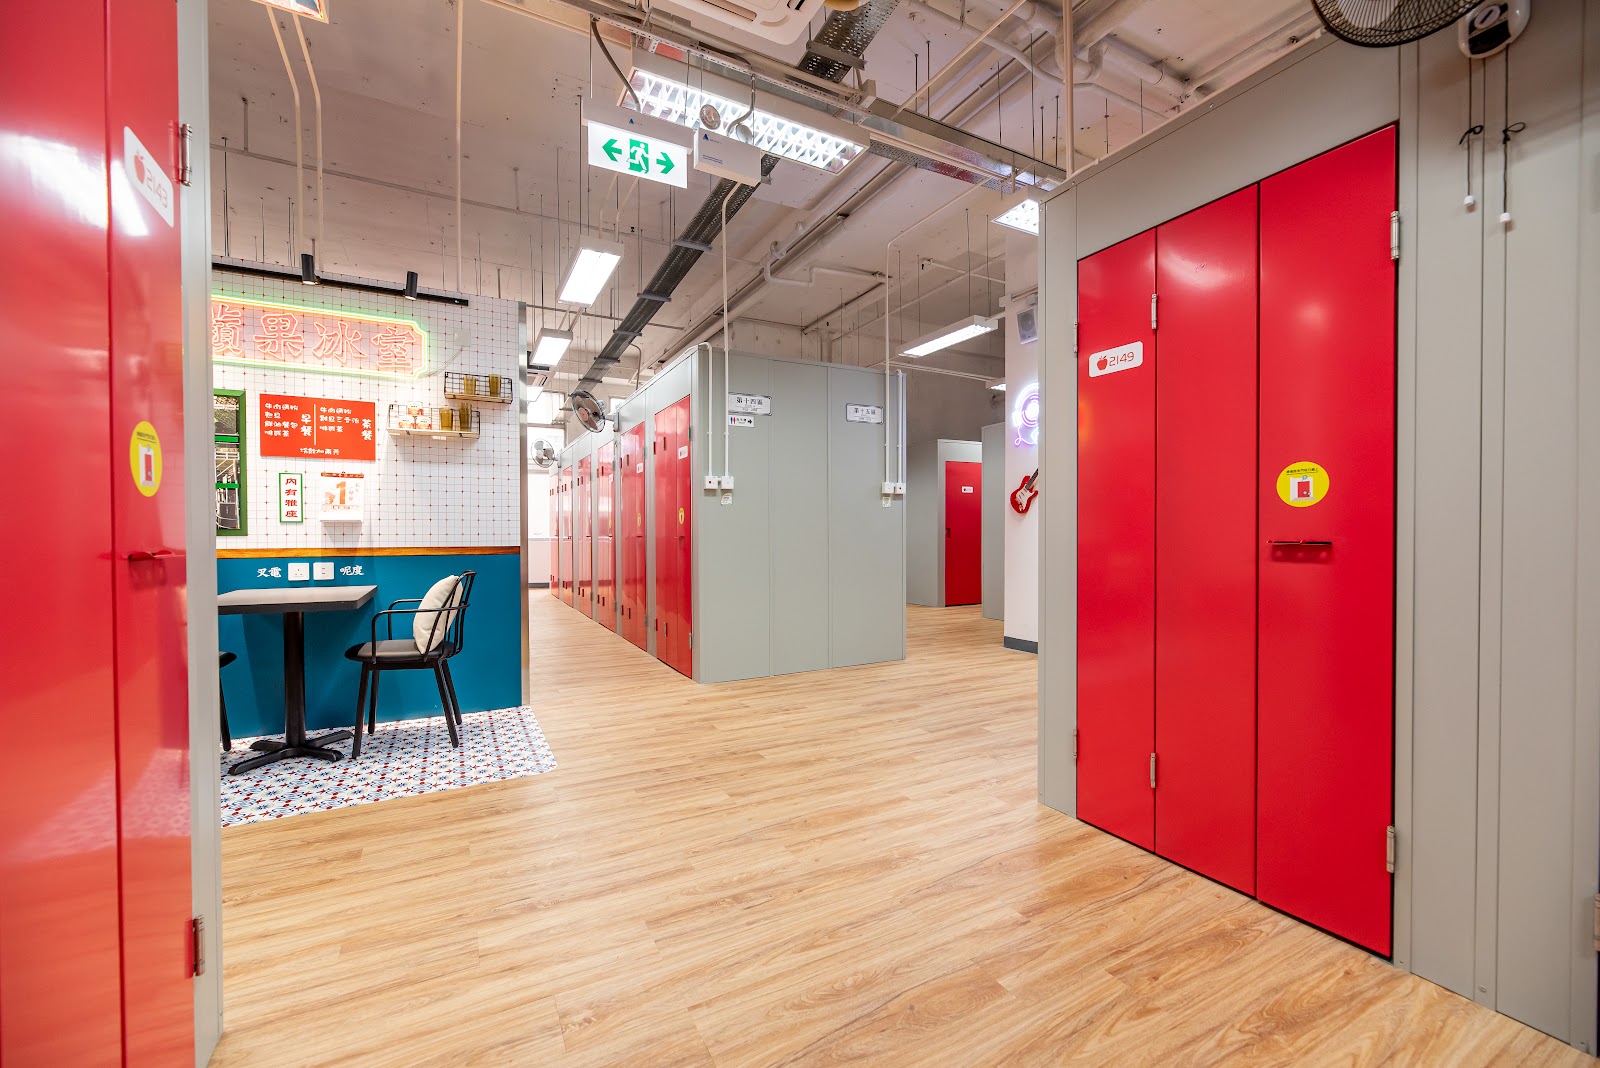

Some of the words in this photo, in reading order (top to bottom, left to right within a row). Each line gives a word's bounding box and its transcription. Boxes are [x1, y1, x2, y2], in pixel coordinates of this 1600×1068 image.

[1109, 351, 1135, 367] 2149
[300, 413, 312, 437] 早餐
[361, 418, 373, 441] 茶餐
[336, 481, 347, 505] 1
[339, 564, 364, 576] 呢度
